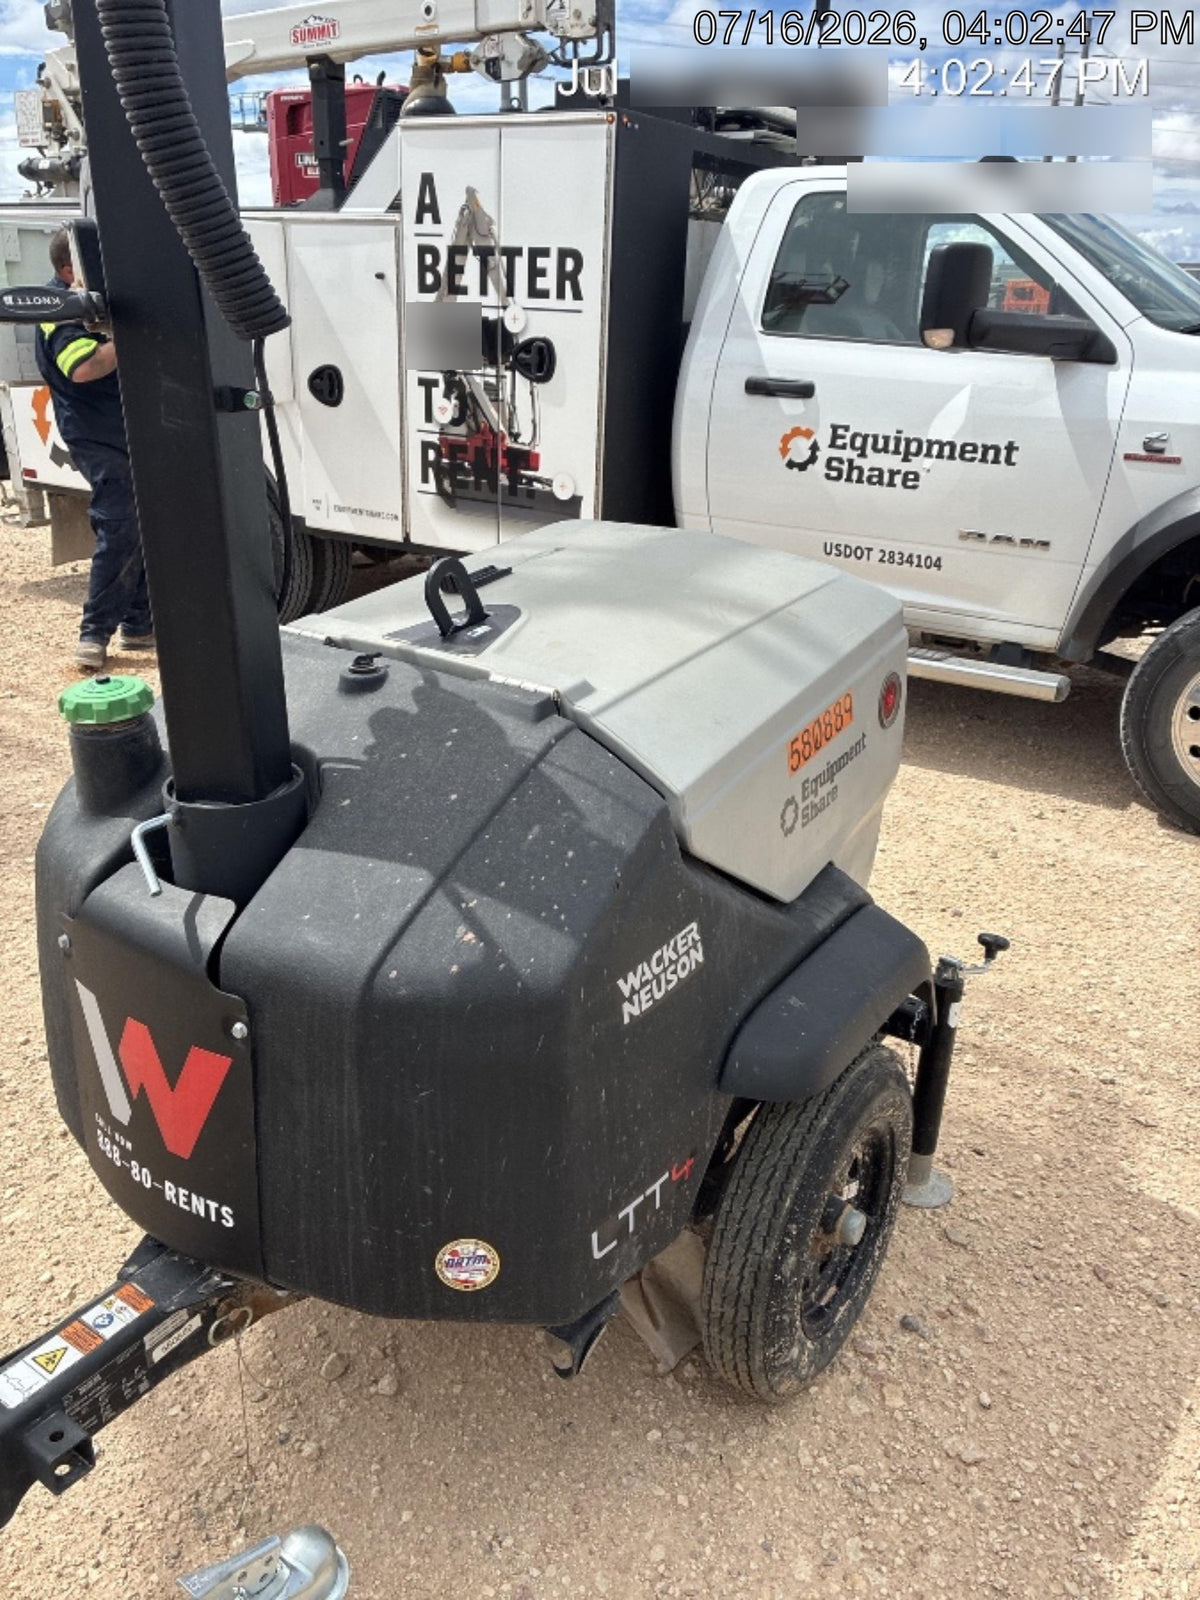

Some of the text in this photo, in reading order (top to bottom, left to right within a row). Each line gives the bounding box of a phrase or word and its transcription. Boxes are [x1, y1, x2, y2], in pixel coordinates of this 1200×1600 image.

[292, 22, 337, 44] SUMMIT
[414, 172, 442, 225] A
[417, 243, 584, 301] BETTER
[16, 296, 61, 305] KNOTT
[417, 376, 468, 427] TO
[828, 423, 1020, 467] Equipment
[824, 456, 921, 490] Share
[823, 541, 942, 571] USDOT 2834104
[789, 692, 853, 772] 580889
[801, 731, 867, 799] Equipment
[801, 785, 839, 829] Share
[616, 921, 701, 998] WACKER
[621, 941, 705, 1025] NEUSON
[97, 1128, 235, 1228] 888-80-RENTS
